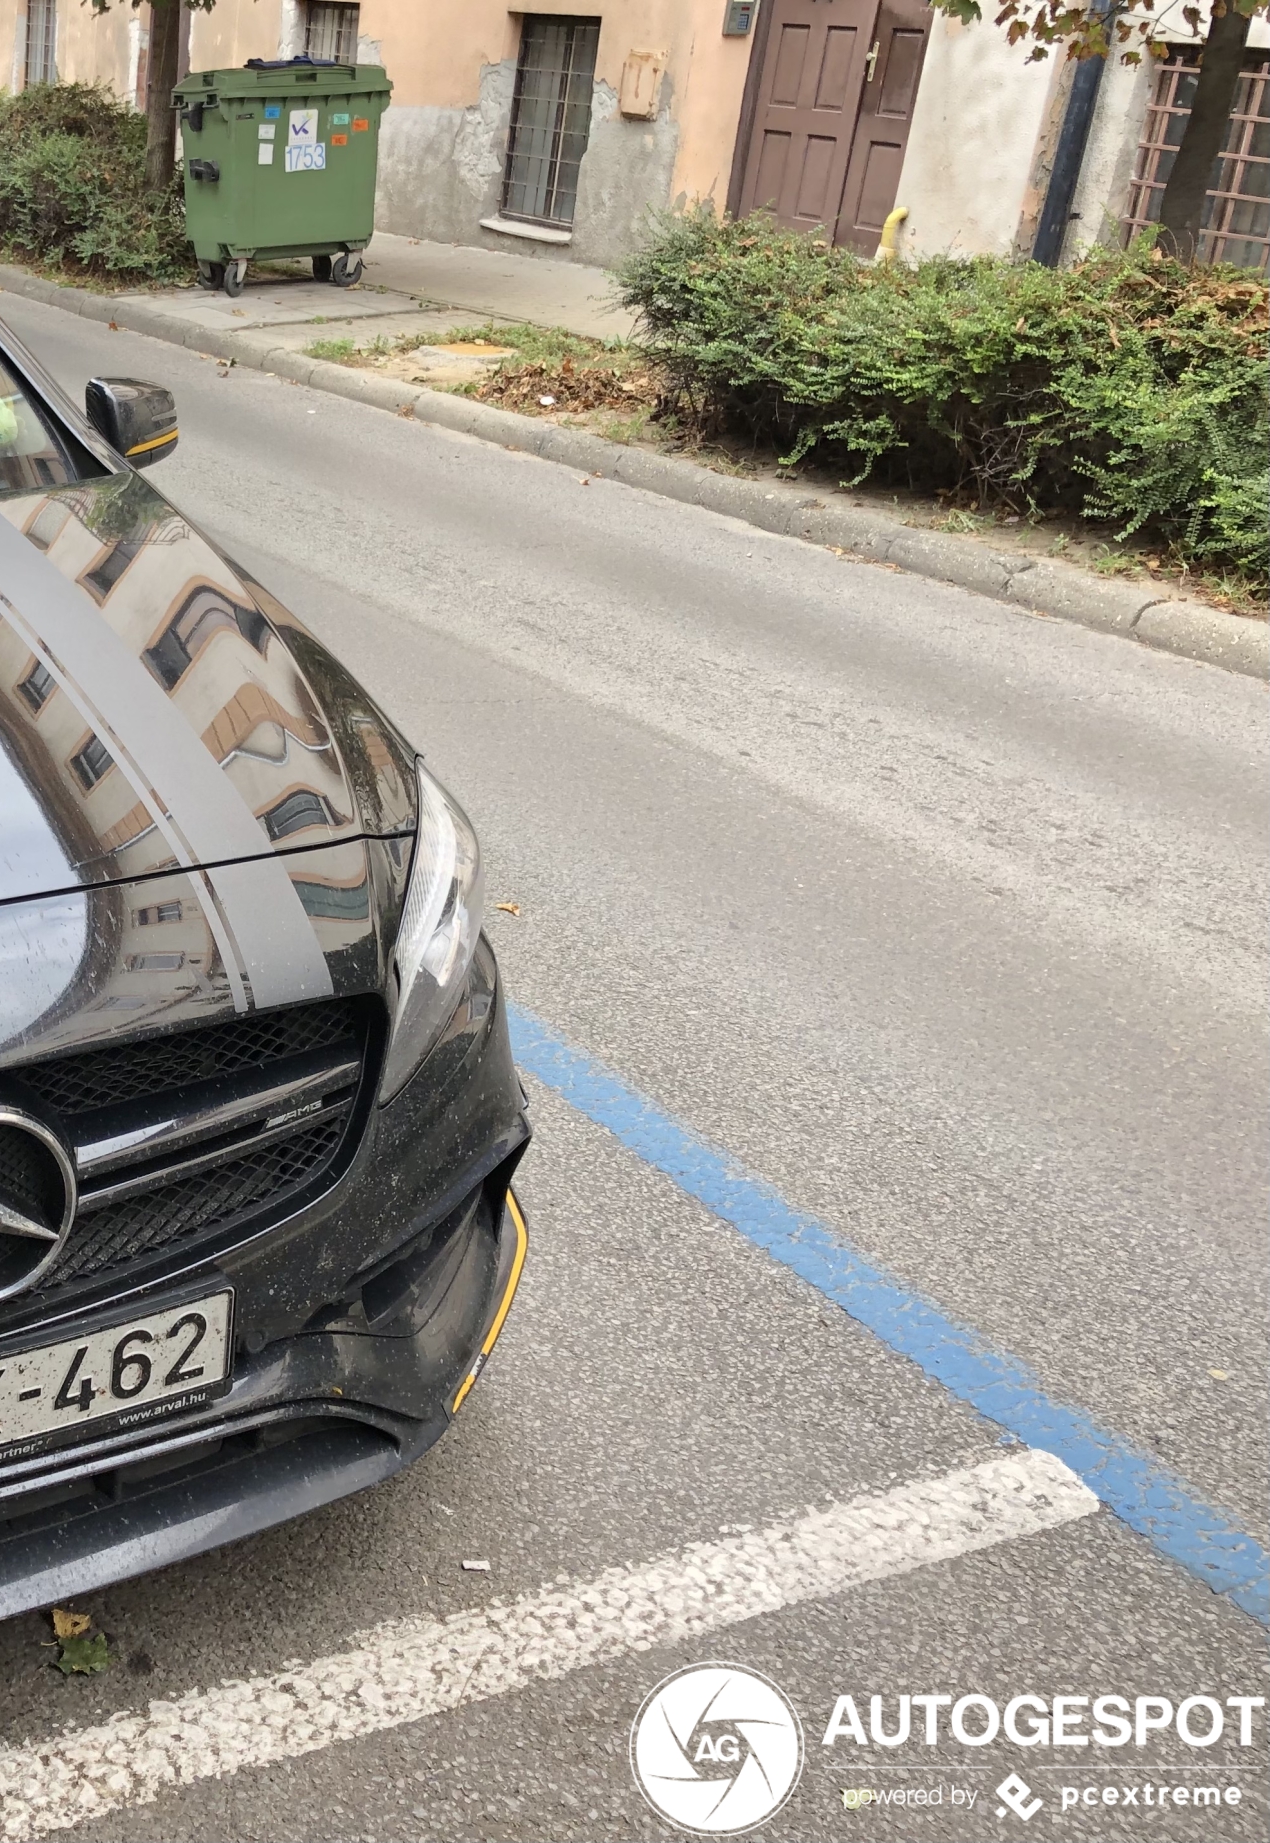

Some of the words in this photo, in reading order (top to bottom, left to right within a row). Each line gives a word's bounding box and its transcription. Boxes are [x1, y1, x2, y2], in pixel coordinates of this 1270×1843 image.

[286, 144, 325, 171] 1753
[284, 1100, 322, 1122] AMG
[119, 1392, 206, 1426] www.arval.hu
